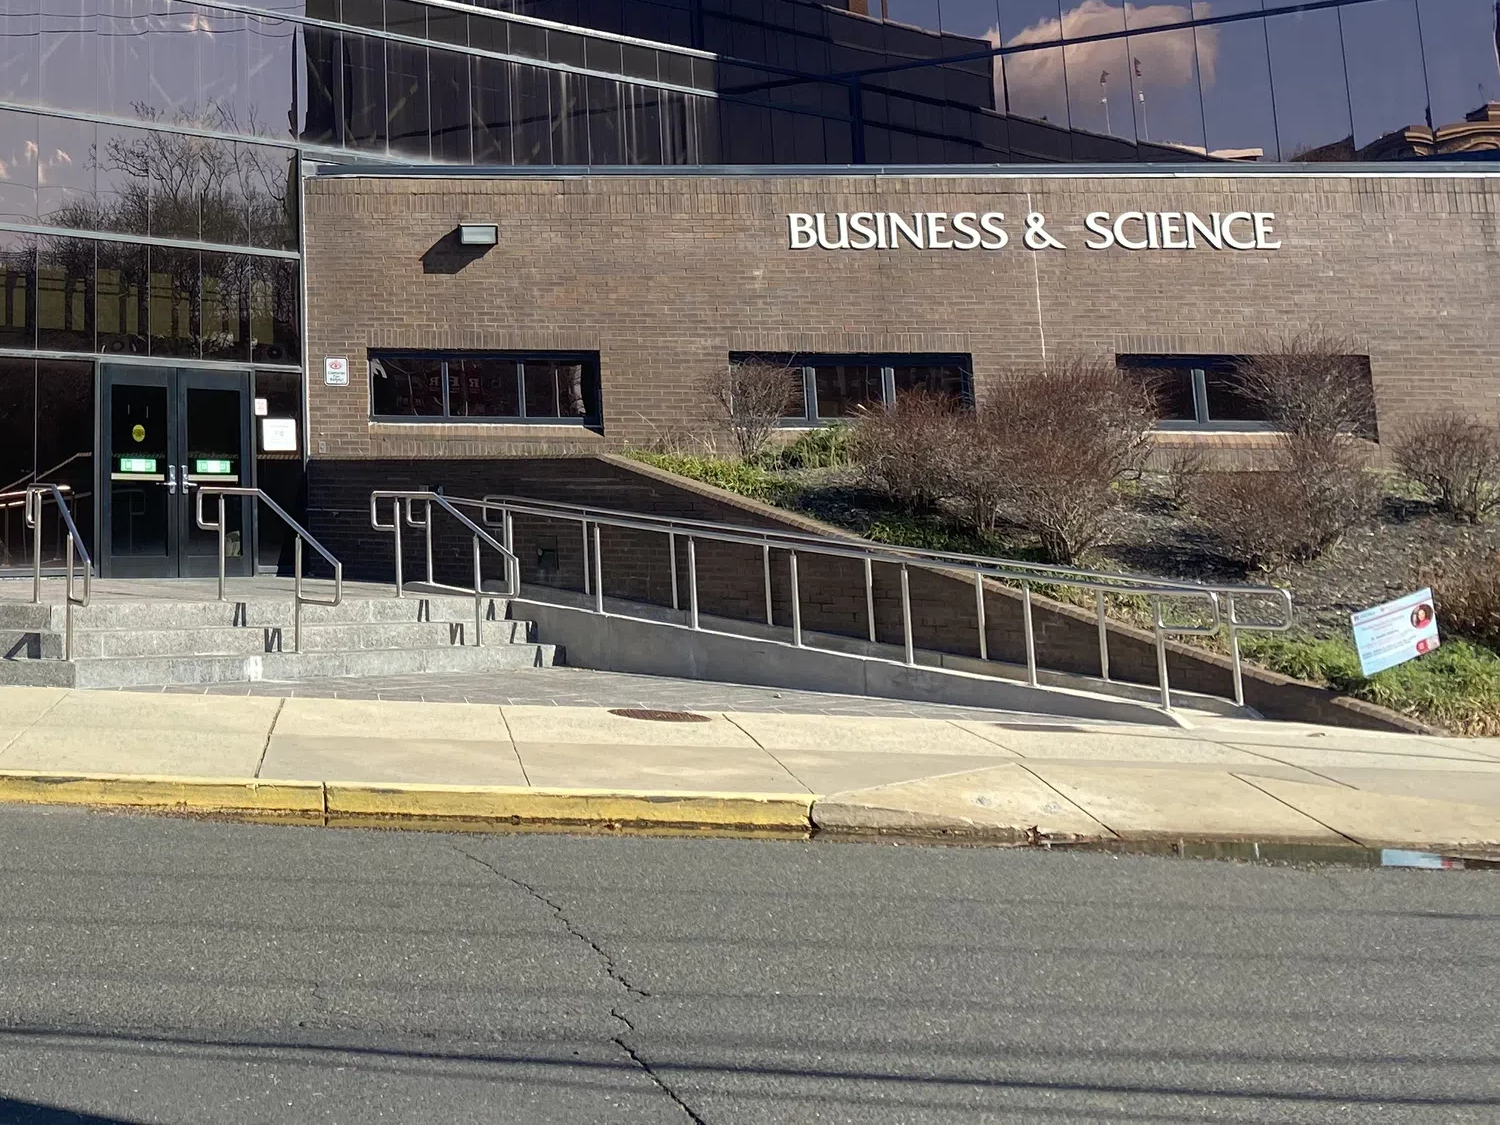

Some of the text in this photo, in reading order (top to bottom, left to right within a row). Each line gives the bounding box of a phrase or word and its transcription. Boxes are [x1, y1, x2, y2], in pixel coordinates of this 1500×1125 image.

[787, 211, 1281, 250] BUSINESS & SCIENCE
